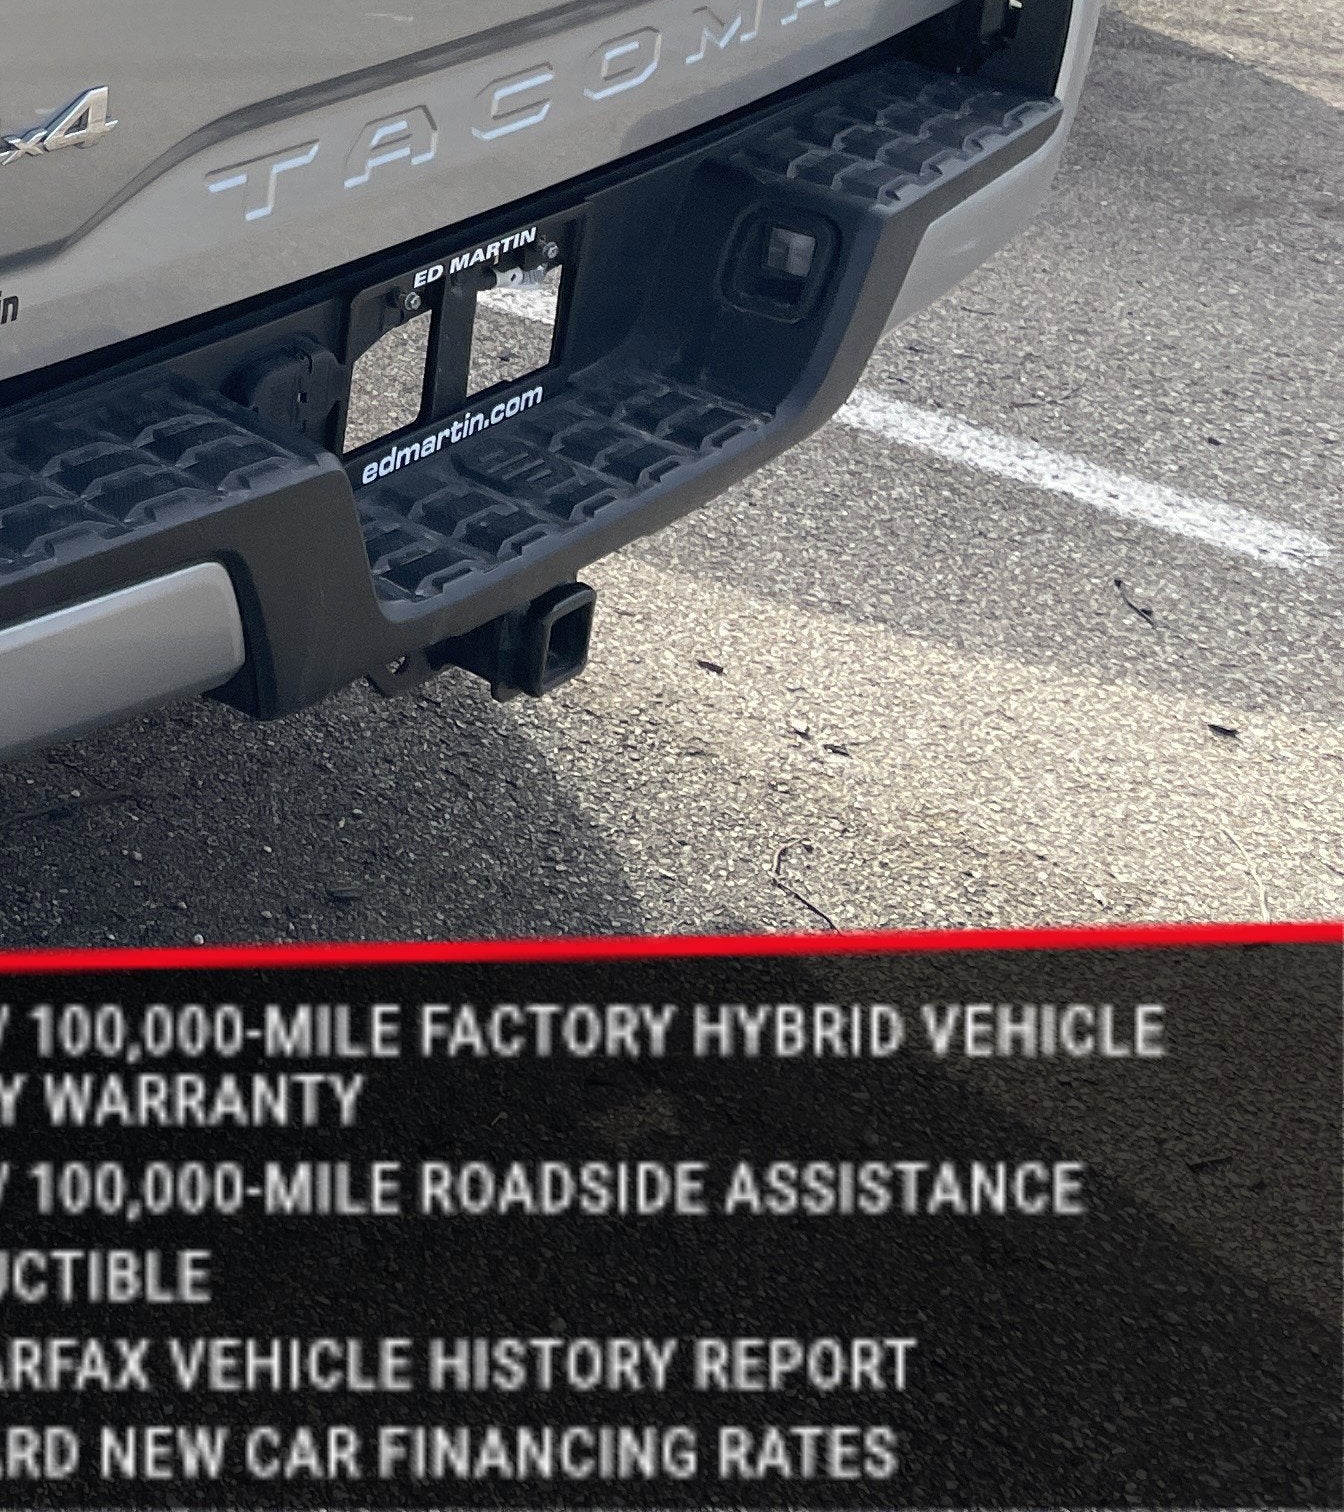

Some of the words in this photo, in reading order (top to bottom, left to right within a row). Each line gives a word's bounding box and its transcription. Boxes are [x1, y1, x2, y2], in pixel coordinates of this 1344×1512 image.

[413, 264, 444, 289] ED
[448, 226, 537, 275] MARTIN
[361, 385, 544, 486] edmartin.com
